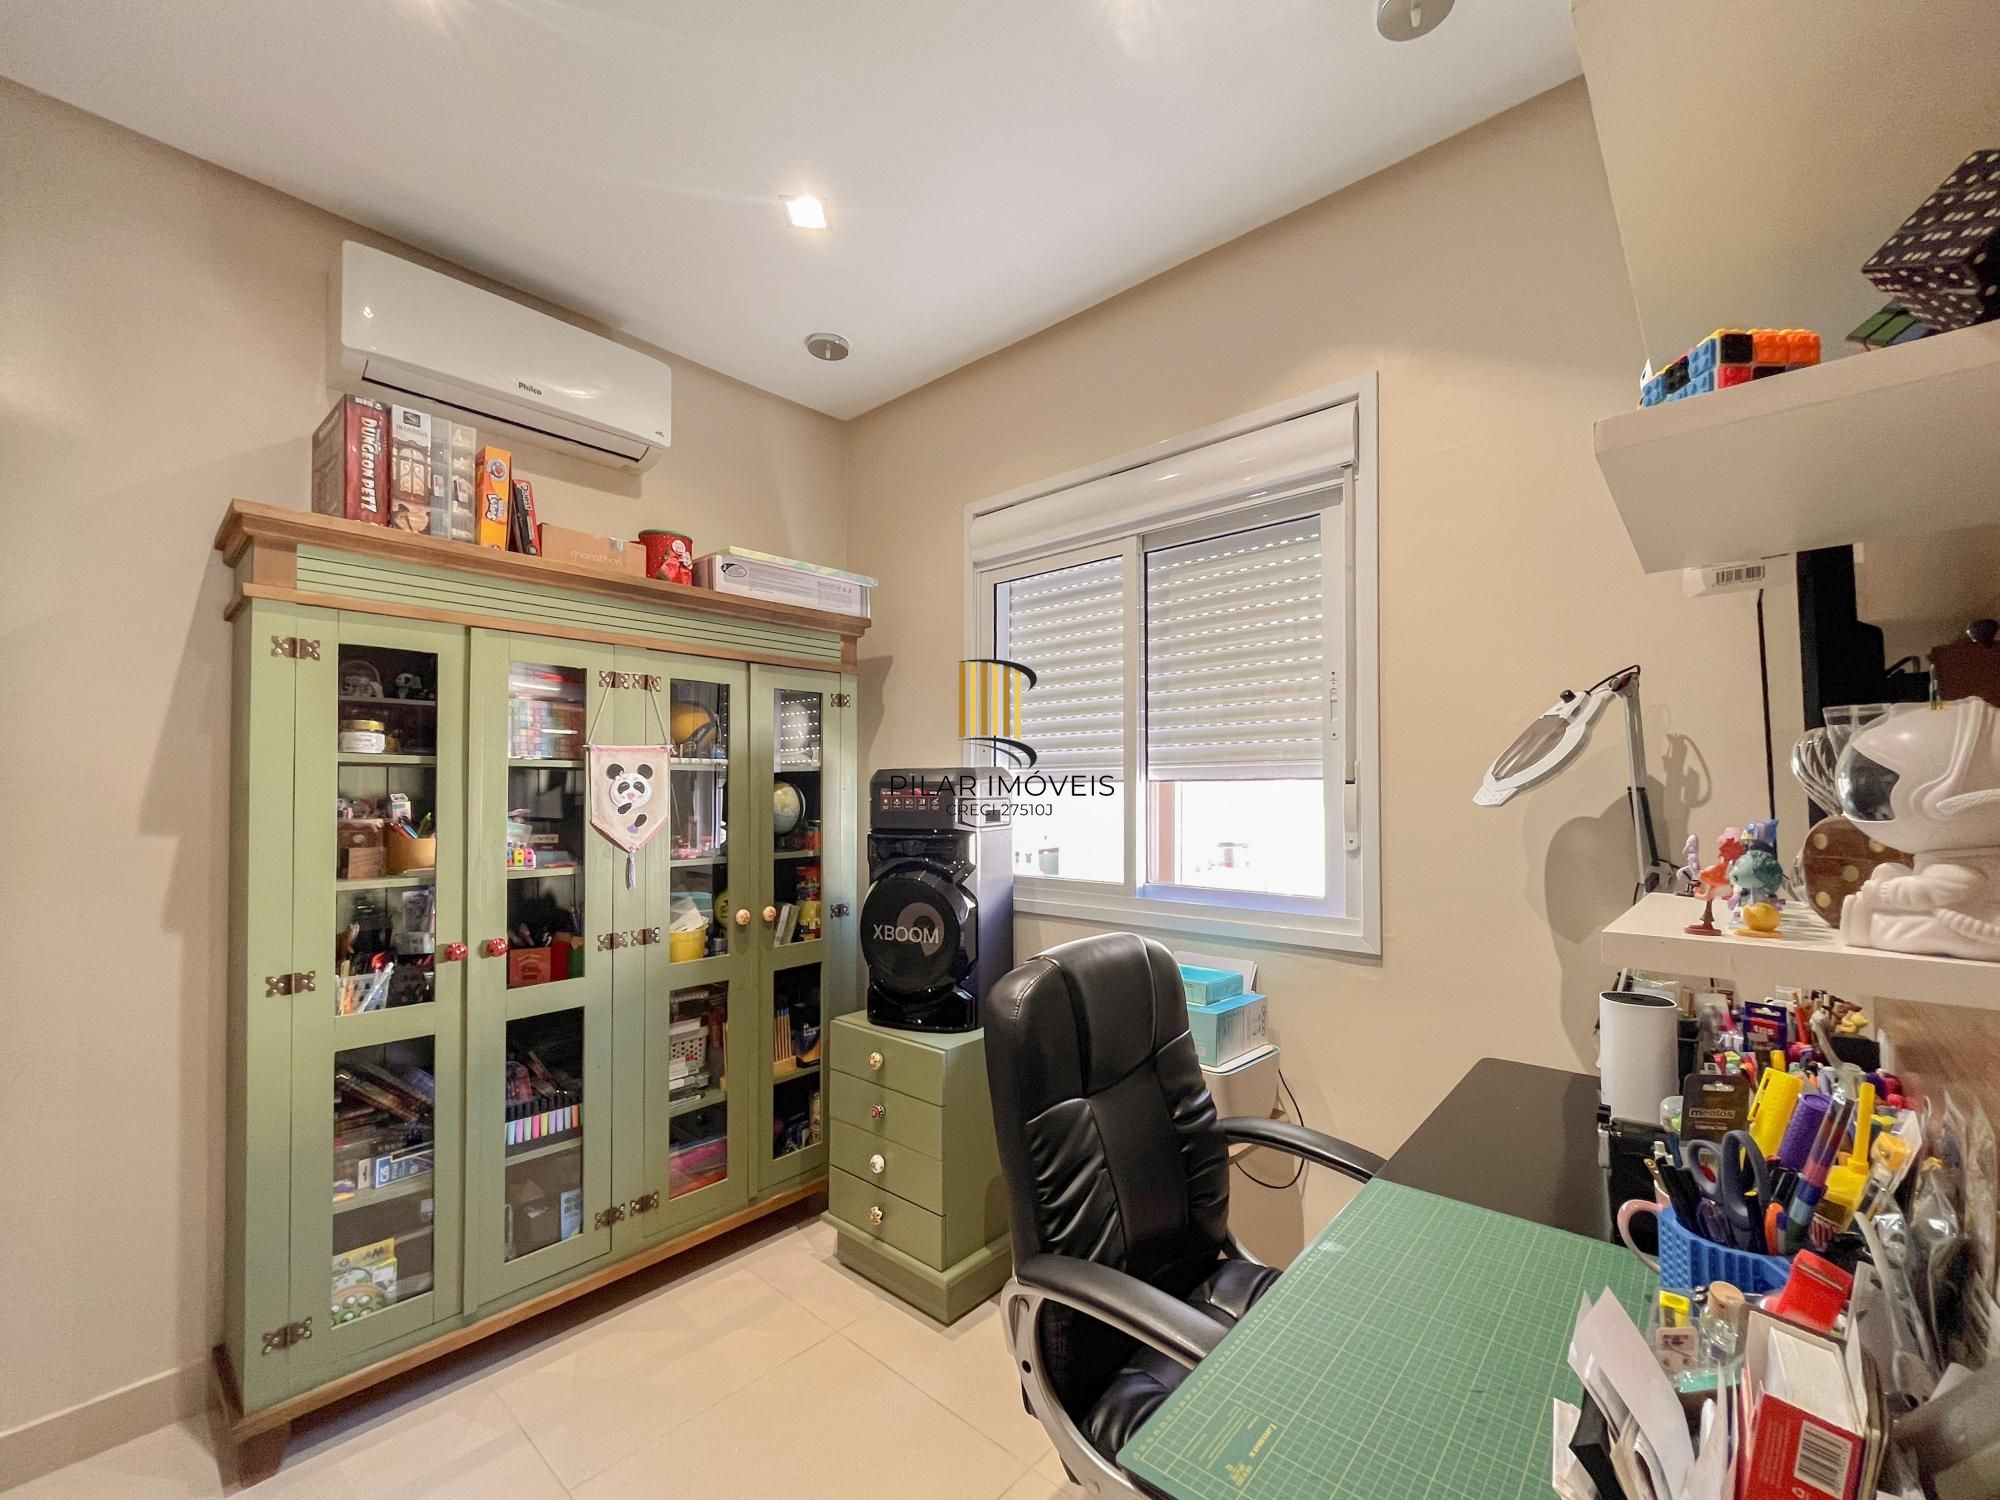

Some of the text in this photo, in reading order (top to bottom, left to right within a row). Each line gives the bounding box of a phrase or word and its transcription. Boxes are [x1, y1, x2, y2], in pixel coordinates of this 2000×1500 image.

[518, 382, 542, 396] Philco
[361, 416, 378, 478] DUNGEON
[360, 479, 378, 513] PETZ
[873, 923, 939, 944] XBOOM
